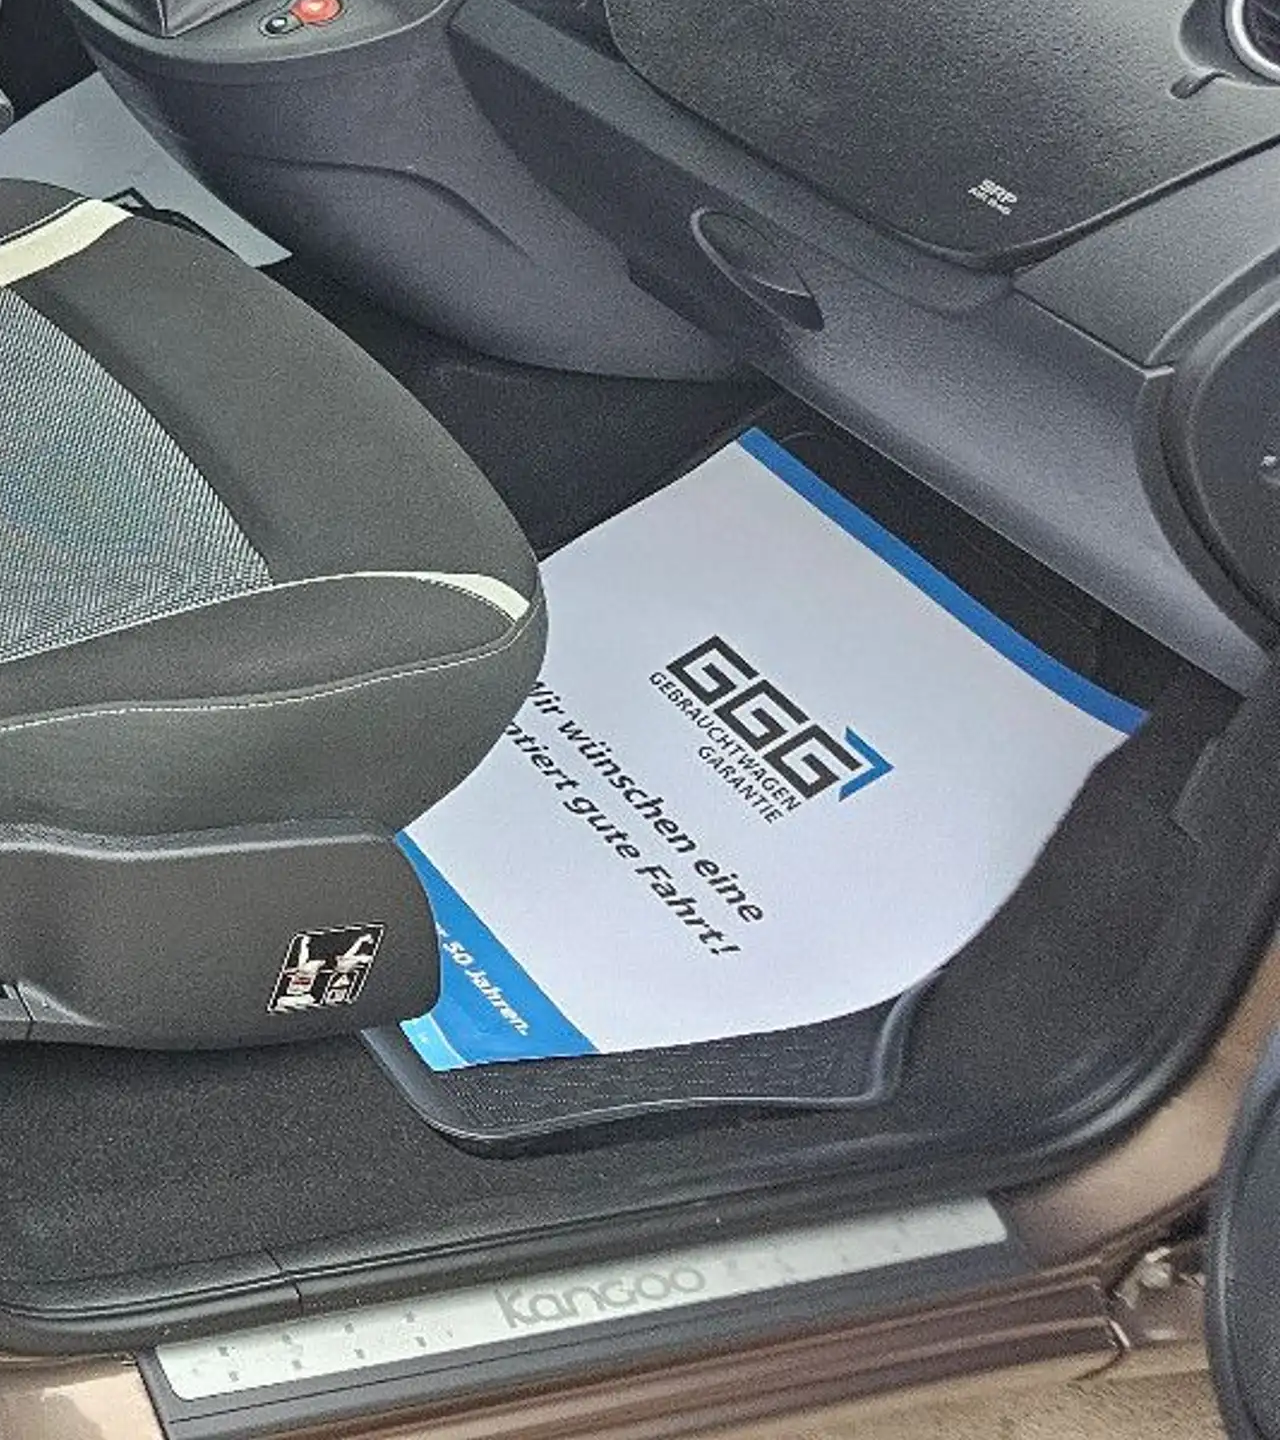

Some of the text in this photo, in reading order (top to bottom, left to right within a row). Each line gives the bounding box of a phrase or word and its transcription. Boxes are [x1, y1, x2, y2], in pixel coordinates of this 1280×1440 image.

[648, 671, 801, 812] GEBRAUCHTWAGEN
[665, 635, 863, 800] GGG
[698, 745, 784, 824] GARANTIE
[505, 722, 742, 955] ntiert gute Fahrt!
[557, 720, 697, 853] wünschen
[694, 859, 765, 923] eine
[444, 941, 530, 1036] 50 Jahren.
